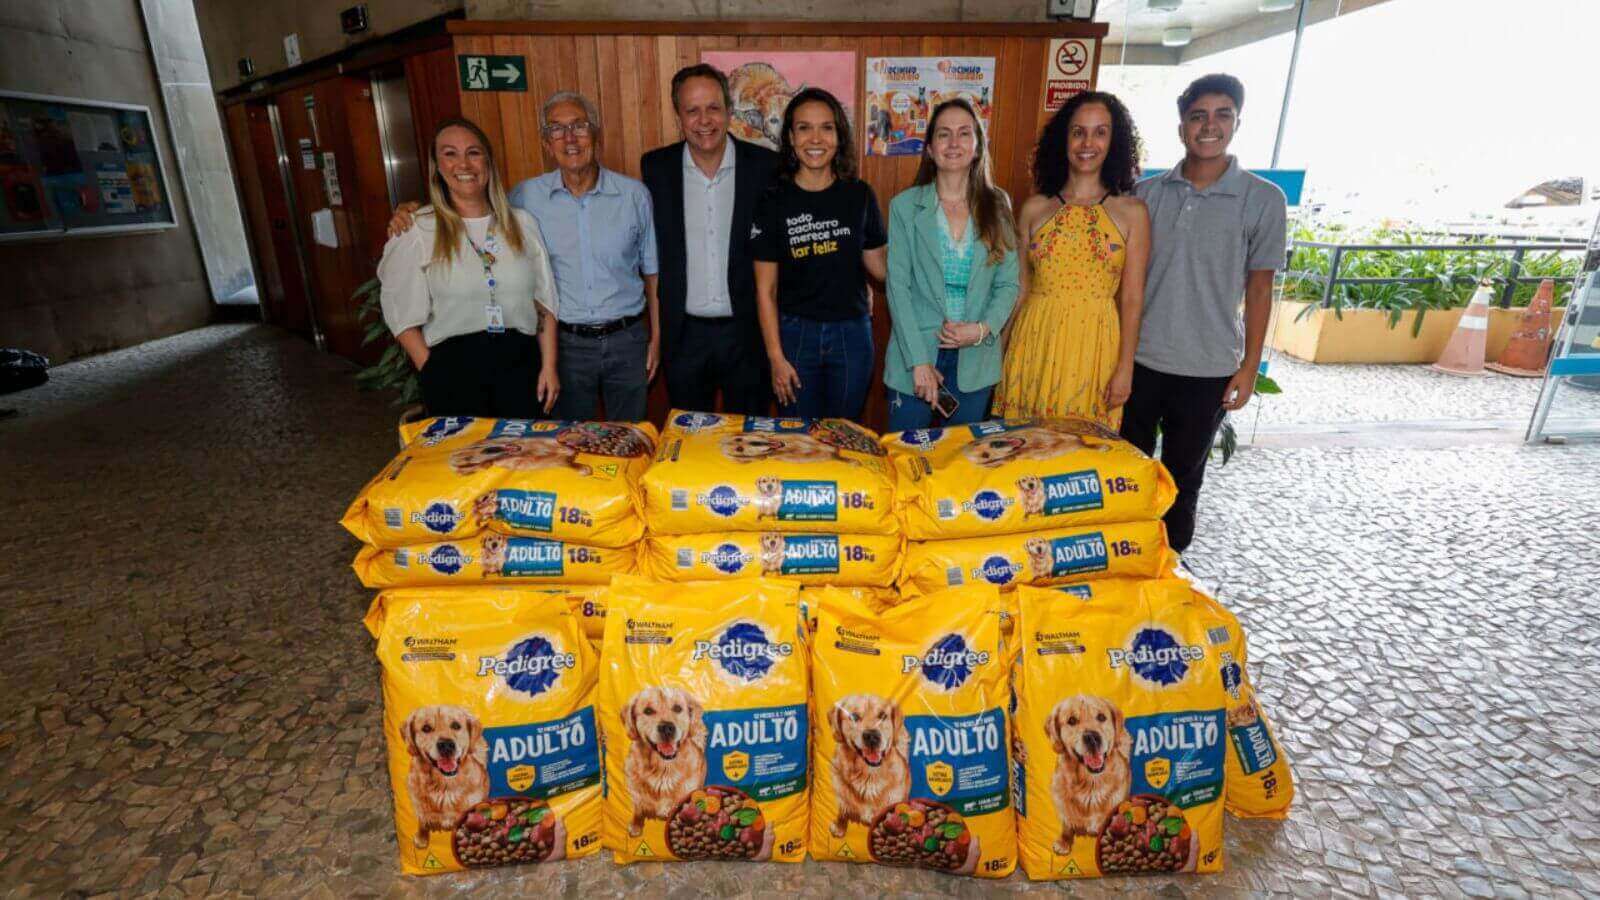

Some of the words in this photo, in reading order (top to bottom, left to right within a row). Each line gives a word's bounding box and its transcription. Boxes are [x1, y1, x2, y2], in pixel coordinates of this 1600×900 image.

[1049, 81, 1088, 89] PROIBIDO
[786, 213, 813, 226] todo
[788, 219, 839, 236] cachorro
[789, 230, 830, 246] merece
[833, 226, 851, 237] um
[791, 245, 810, 258] lar
[812, 240, 838, 257] feliz
[784, 487, 836, 507] ADULTO
[1048, 477, 1100, 500] ADULTO
[500, 496, 553, 518] ADULTO
[508, 546, 562, 563] ADULTO
[785, 543, 838, 559] ADULTO
[1055, 541, 1106, 564] ADULTO
[693, 640, 793, 661] Pedigree
[902, 649, 990, 673] Pdigree
[1107, 646, 1205, 668] Pedigree
[477, 650, 575, 677] Pedigree
[492, 722, 586, 764] ADULTO
[710, 716, 798, 748] ADULTO
[912, 722, 999, 757] ADULTO
[1133, 721, 1219, 757] ADULTO
[1246, 726, 1273, 768] ADULTO
